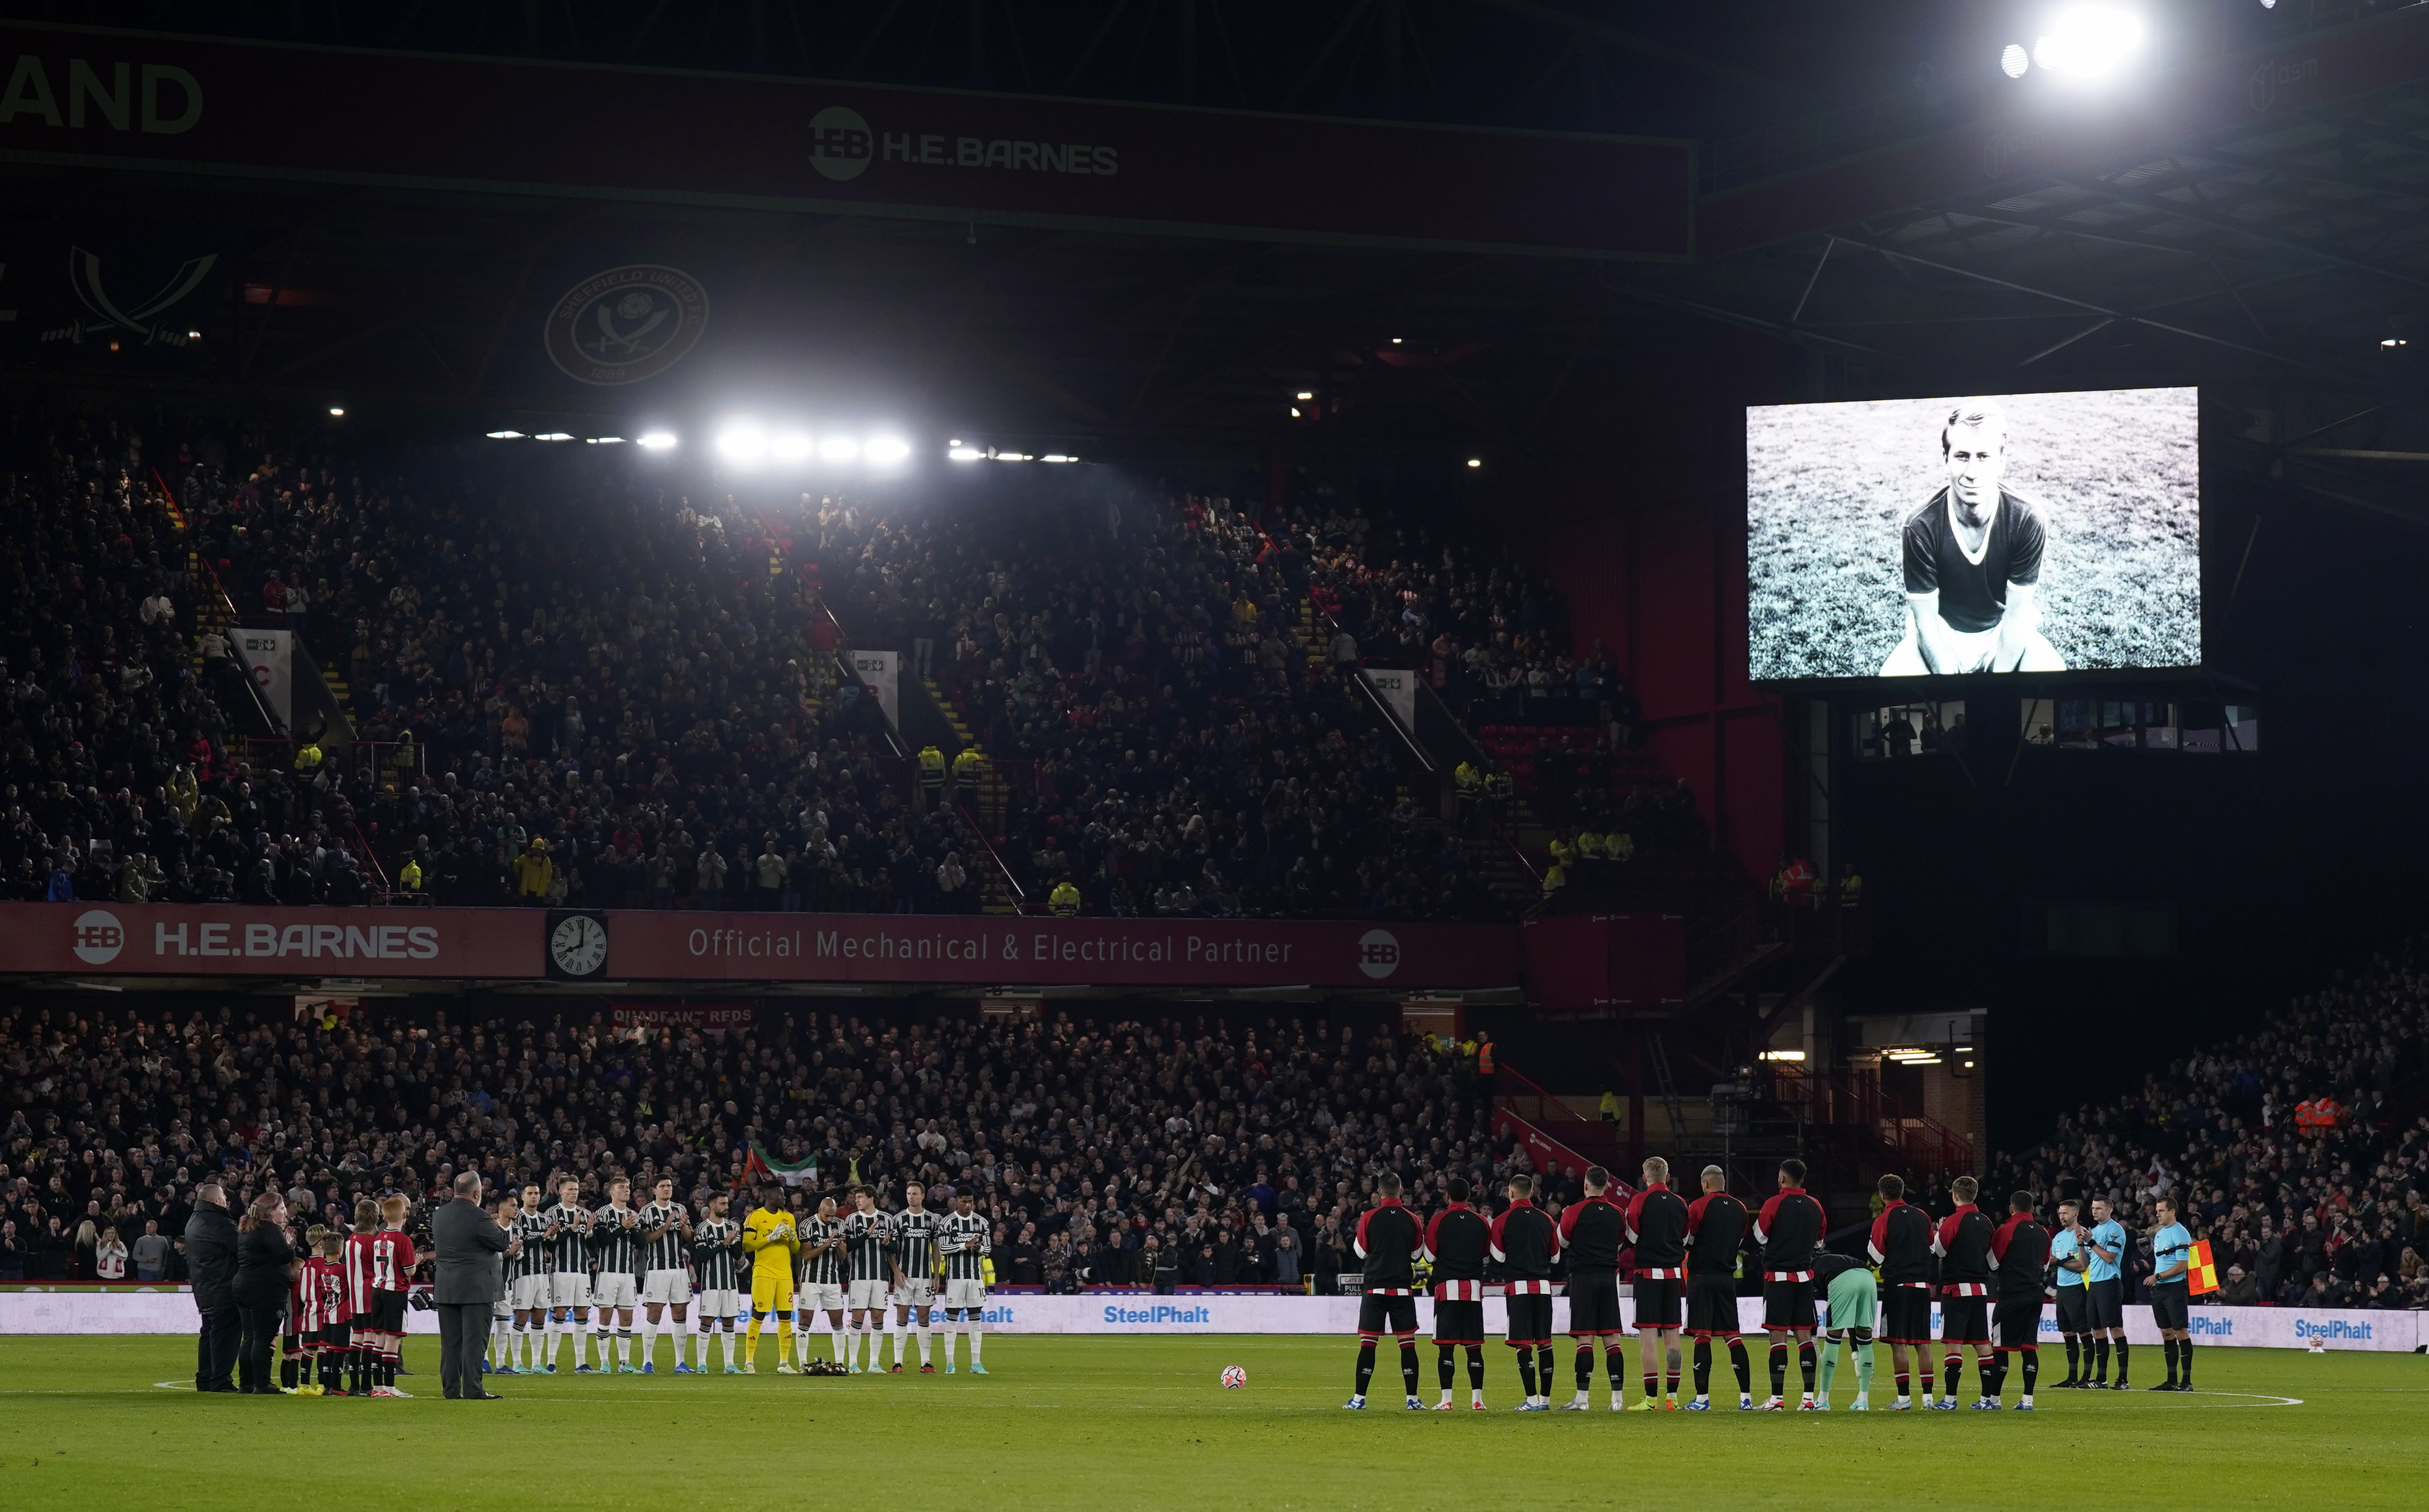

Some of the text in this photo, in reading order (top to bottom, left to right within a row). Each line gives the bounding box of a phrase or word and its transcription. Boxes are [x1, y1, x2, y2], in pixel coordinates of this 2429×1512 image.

[883, 132, 1118, 176] H.E.BARNES
[559, 271, 643, 319] SHEFFIELD
[650, 271, 697, 303] UNITED
[155, 922, 439, 959] H.E.BARNES
[689, 928, 1292, 963] Official Mechanical & Electrical Partner
[1104, 1305, 1209, 1323] SteelPhalt
[2295, 1319, 2372, 1339] SteelPhalt
